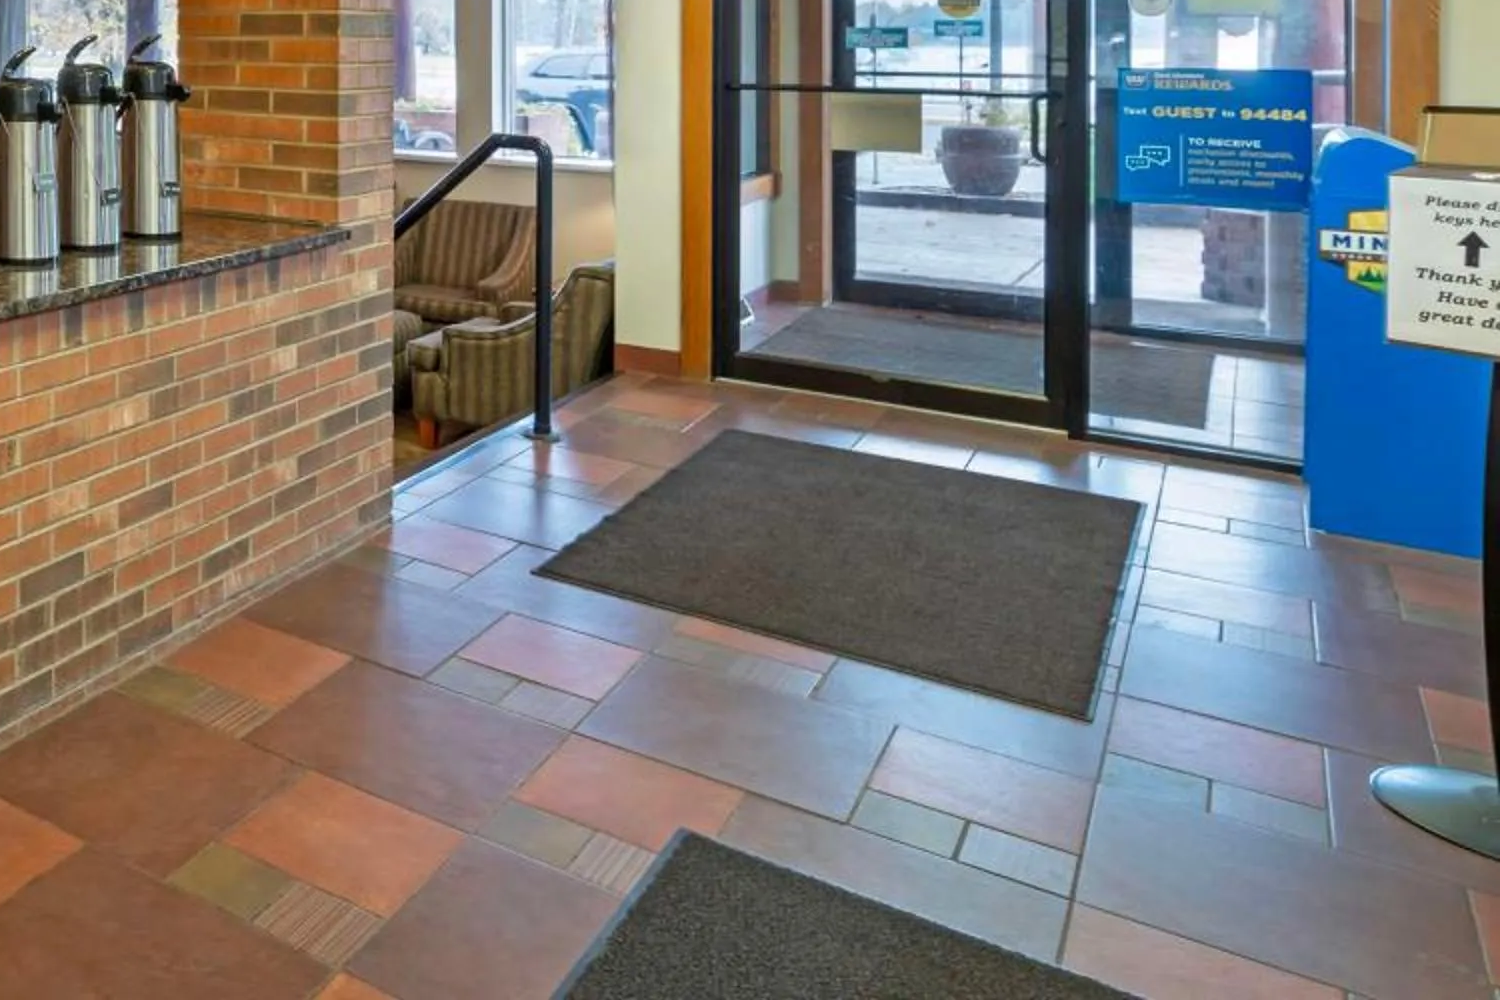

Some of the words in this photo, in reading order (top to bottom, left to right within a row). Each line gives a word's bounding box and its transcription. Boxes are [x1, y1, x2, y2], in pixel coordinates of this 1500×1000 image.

[1152, 105, 1217, 119] GUEST
[1222, 109, 1236, 118] to
[1240, 108, 1307, 121] 94484
[1188, 137, 1204, 146] TO
[1207, 138, 1261, 149] RECEIVE
[1425, 195, 1481, 210] Please
[1434, 212, 1474, 228] keys
[1415, 266, 1483, 287] Thank
[1437, 290, 1489, 309] Have
[1418, 311, 1474, 327] great
